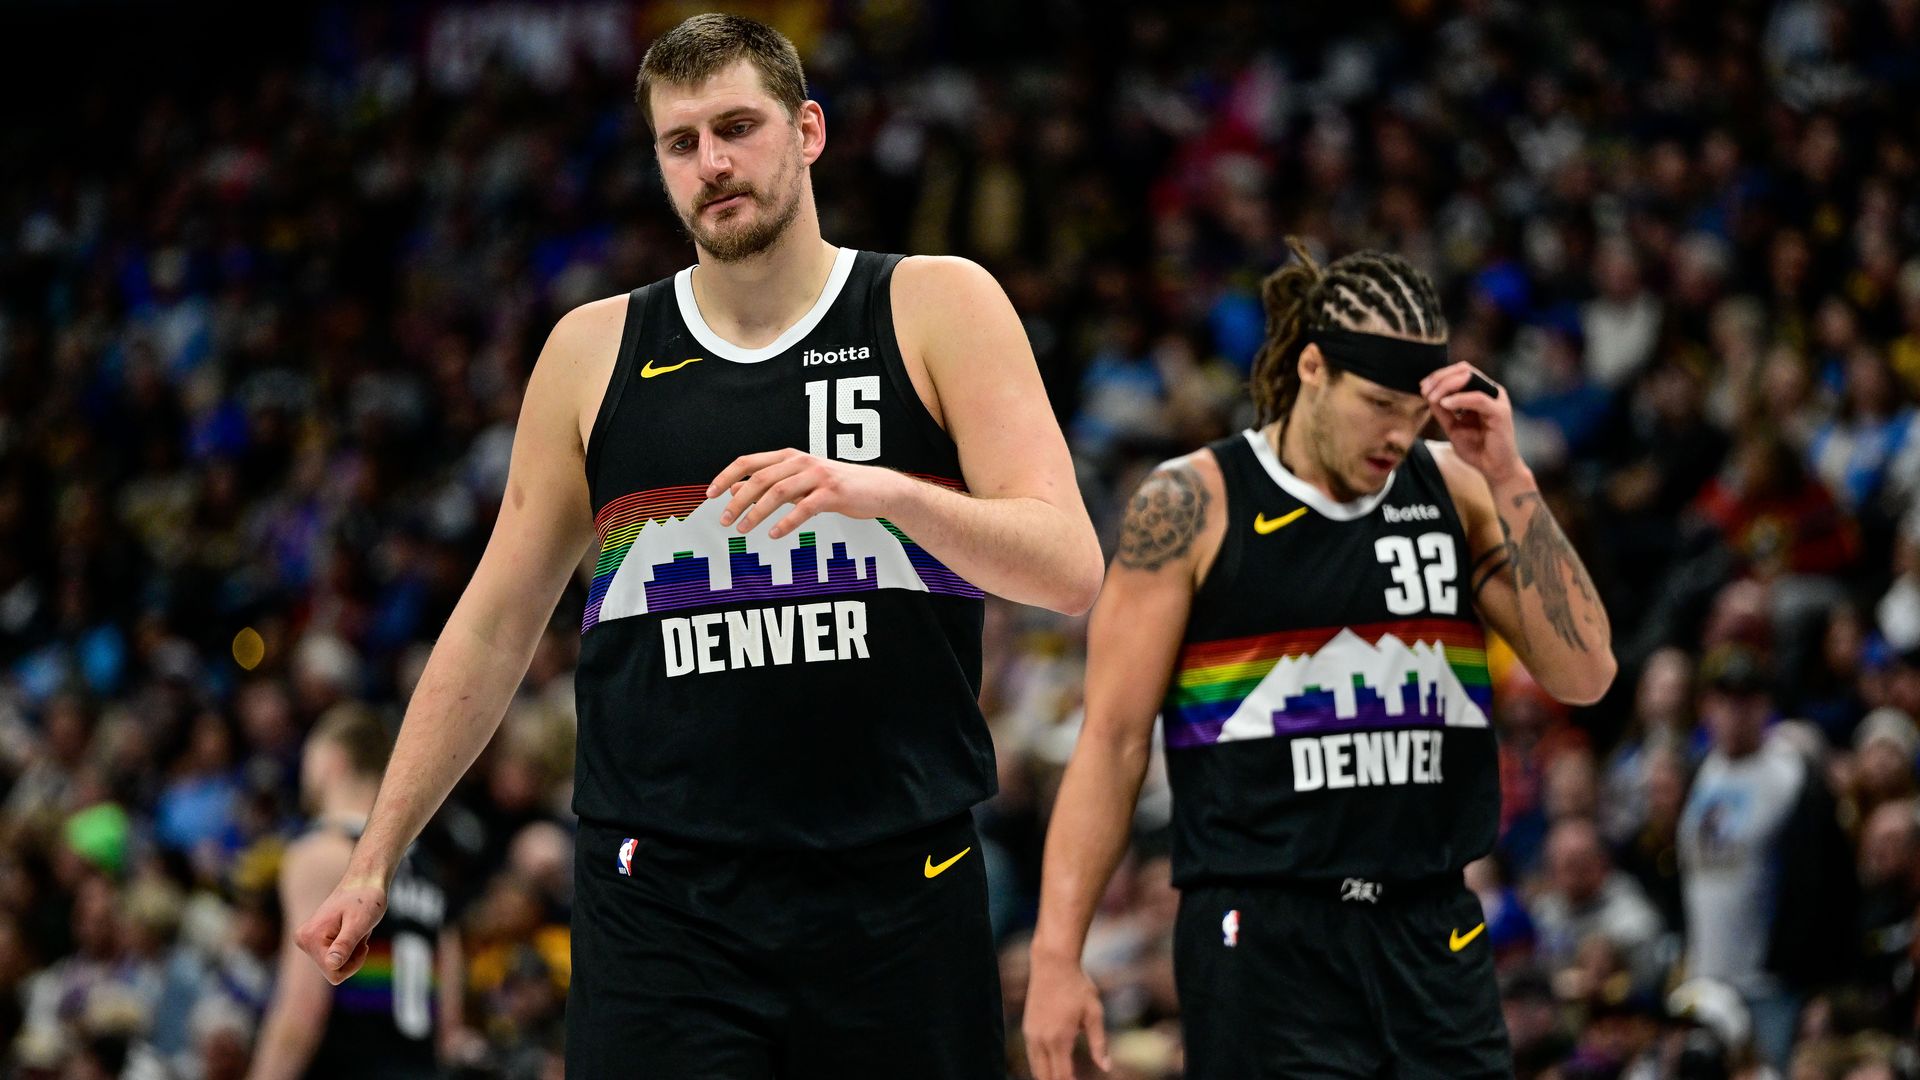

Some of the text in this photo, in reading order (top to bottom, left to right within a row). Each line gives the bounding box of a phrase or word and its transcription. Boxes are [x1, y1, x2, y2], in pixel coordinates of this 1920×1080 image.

[803, 346, 870, 367] ibotta
[805, 375, 881, 461] 15
[1382, 504, 1440, 523] ibotta
[1374, 532, 1458, 615] 32
[661, 600, 871, 678] DENVER
